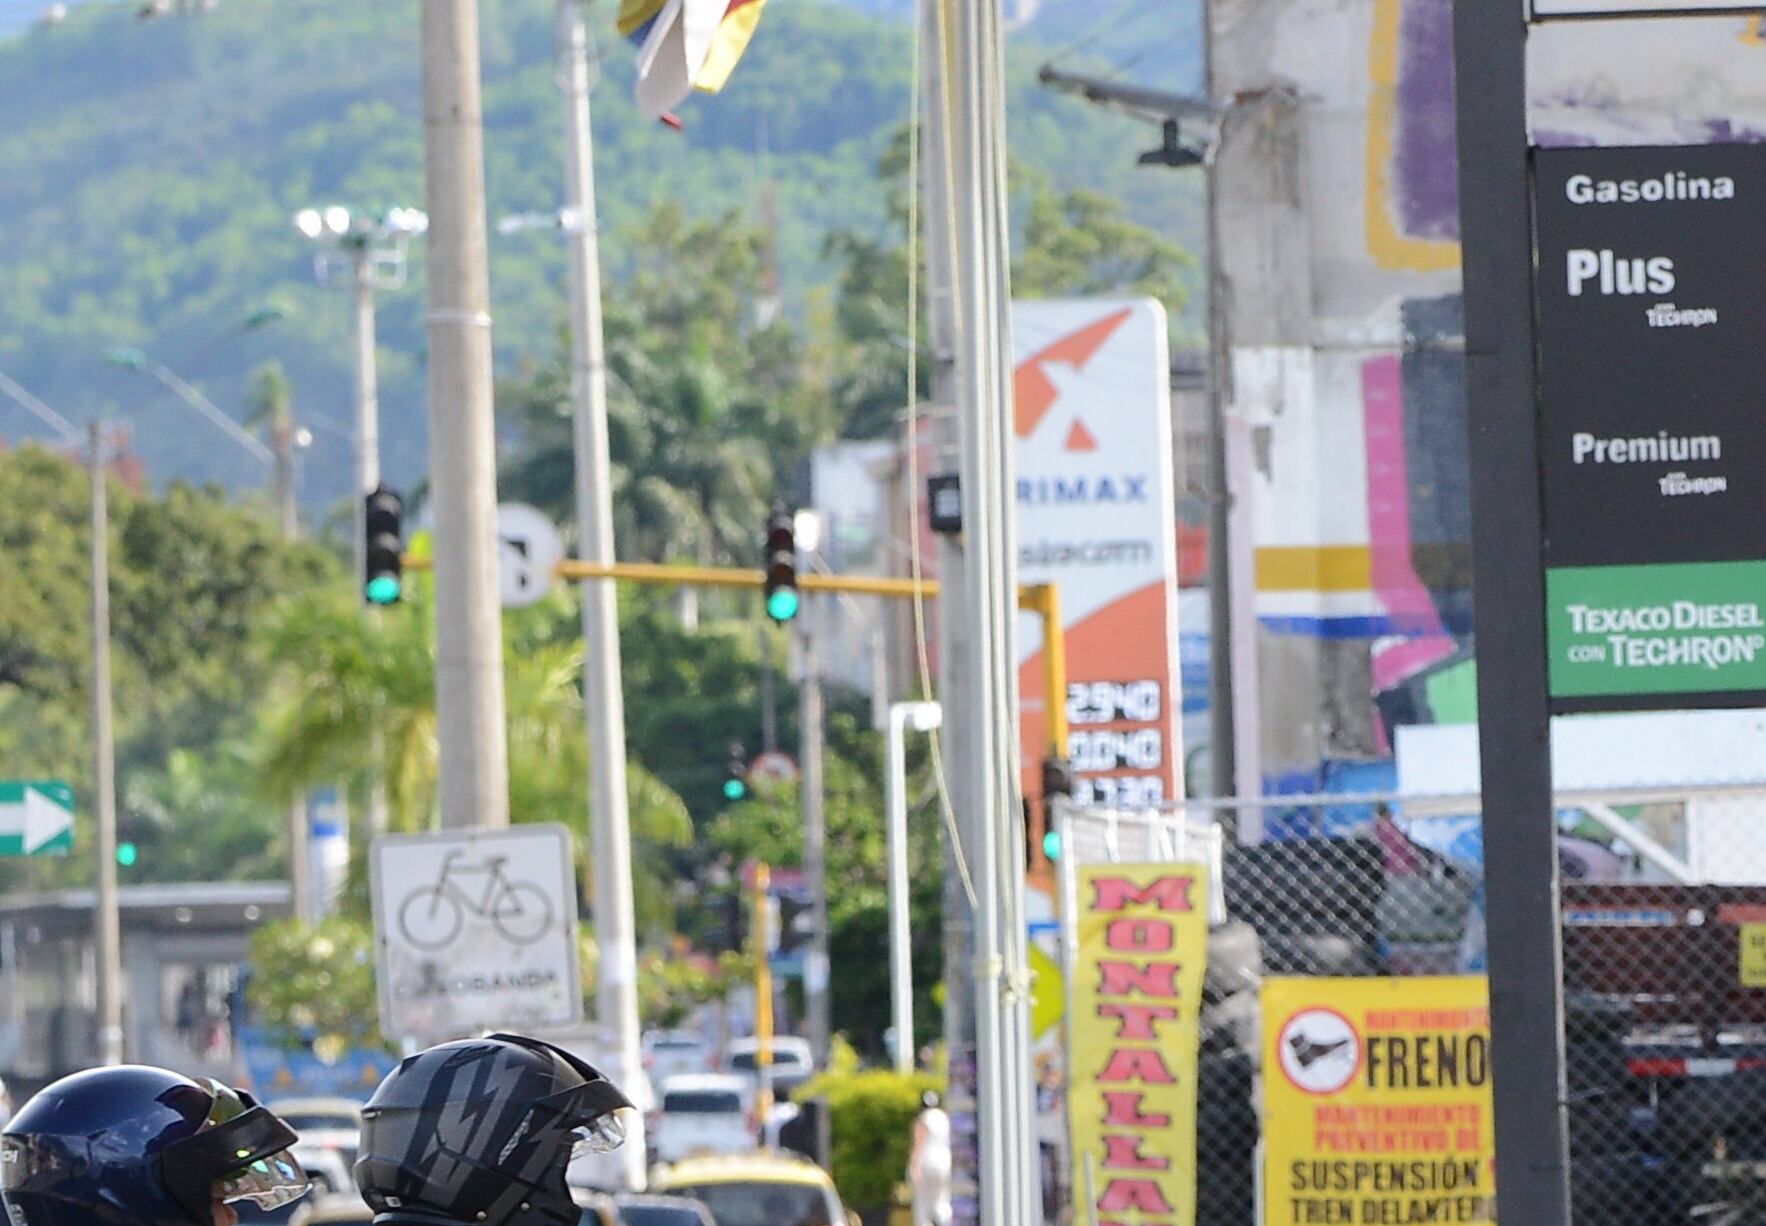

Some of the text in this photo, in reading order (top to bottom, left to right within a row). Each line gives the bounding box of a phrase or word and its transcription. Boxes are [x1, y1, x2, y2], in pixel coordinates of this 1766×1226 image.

[1566, 171, 1735, 204] Gasolina
[1567, 249, 1676, 296] Plus
[1573, 430, 1721, 464] Premium
[1566, 601, 1765, 633] TEXACO DIESEL
[1290, 1154, 1480, 1191] SUSPENSIÓN
[1290, 1198, 1354, 1225] TREN
